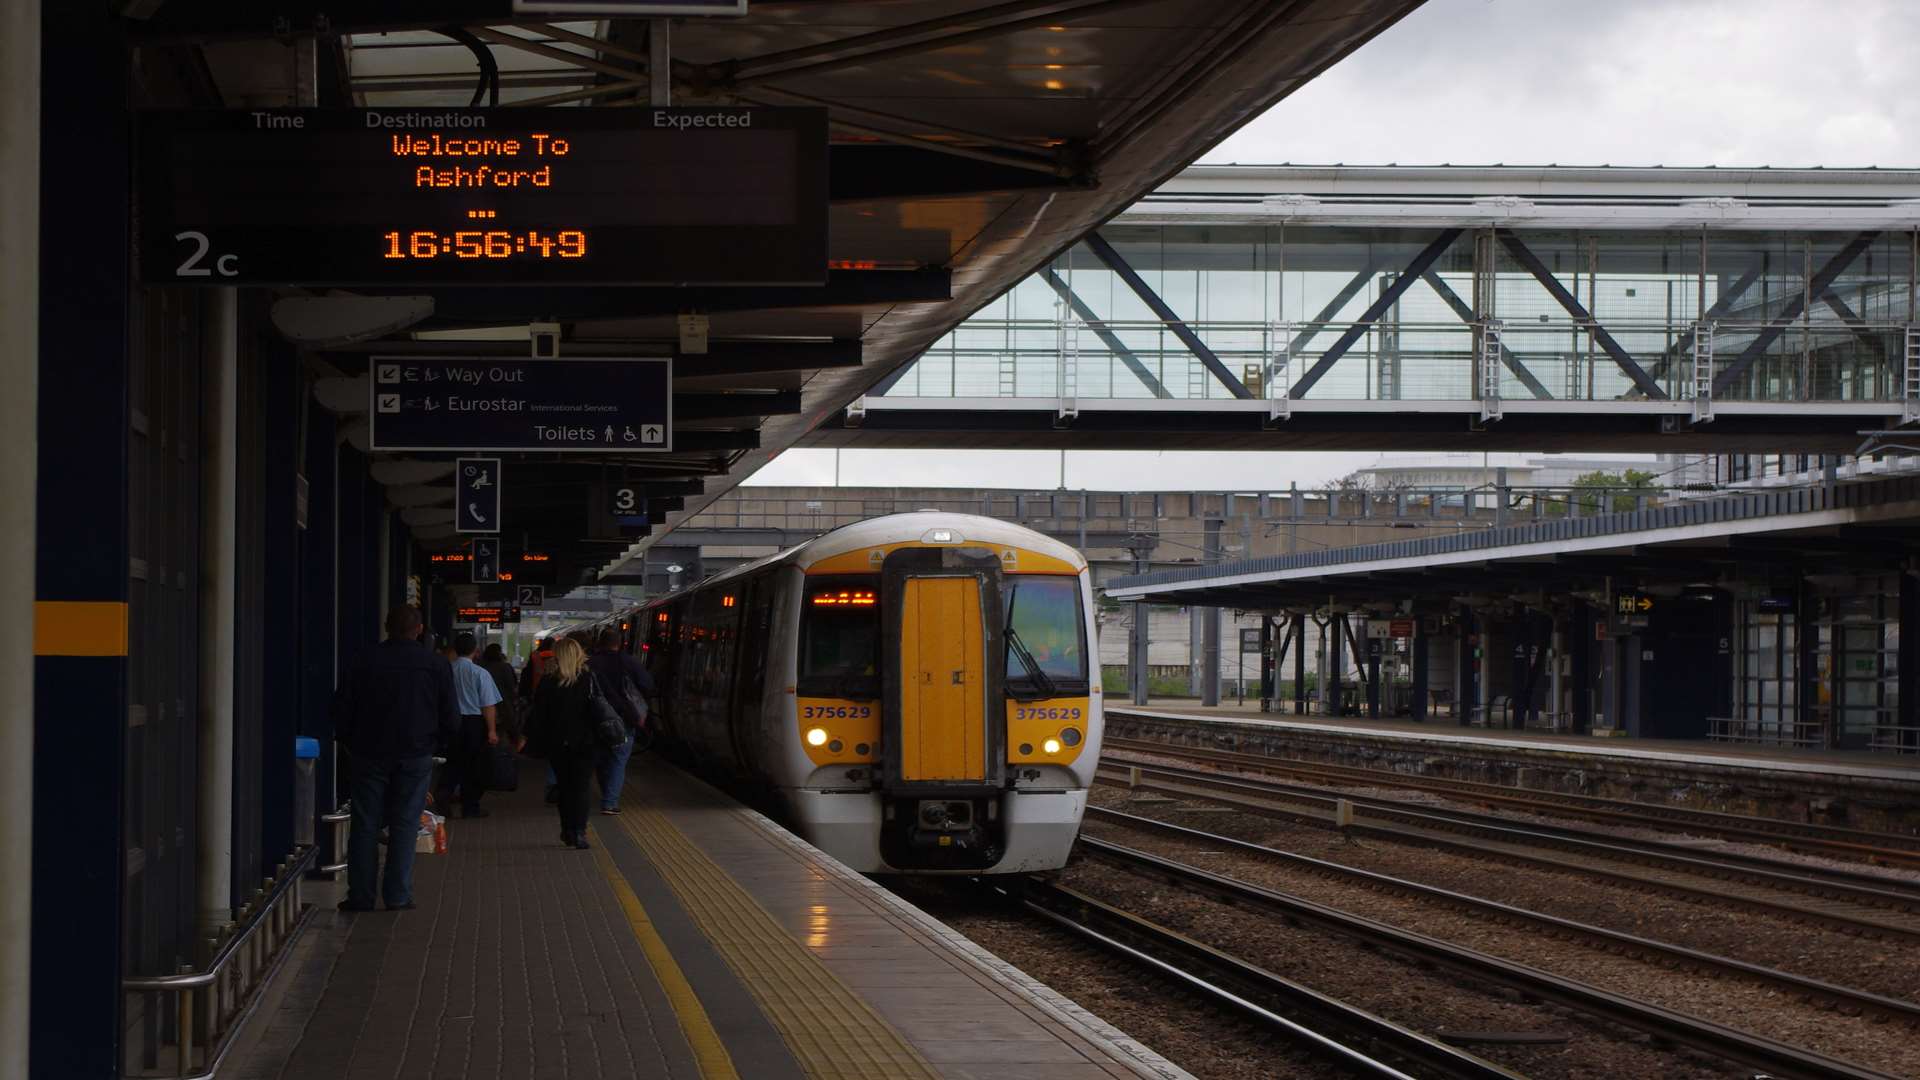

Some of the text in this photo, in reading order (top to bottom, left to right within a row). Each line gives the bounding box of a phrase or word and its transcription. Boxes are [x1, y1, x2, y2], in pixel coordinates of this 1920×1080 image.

[252, 111, 751, 131] Time Destination Expected
[393, 134, 569, 156] Welcome To
[415, 165, 550, 187] Ashford
[175, 231, 239, 277] 2c
[384, 230, 586, 259] 16:56:49
[446, 367, 524, 386] Way Out
[448, 397, 526, 411] Eurostar
[530, 403, 582, 412] International
[534, 425, 596, 441] Toilets
[616, 488, 635, 509] 3
[1719, 638, 1729, 649] 5
[803, 706, 871, 719] 375629
[1016, 707, 1081, 721] 375629
